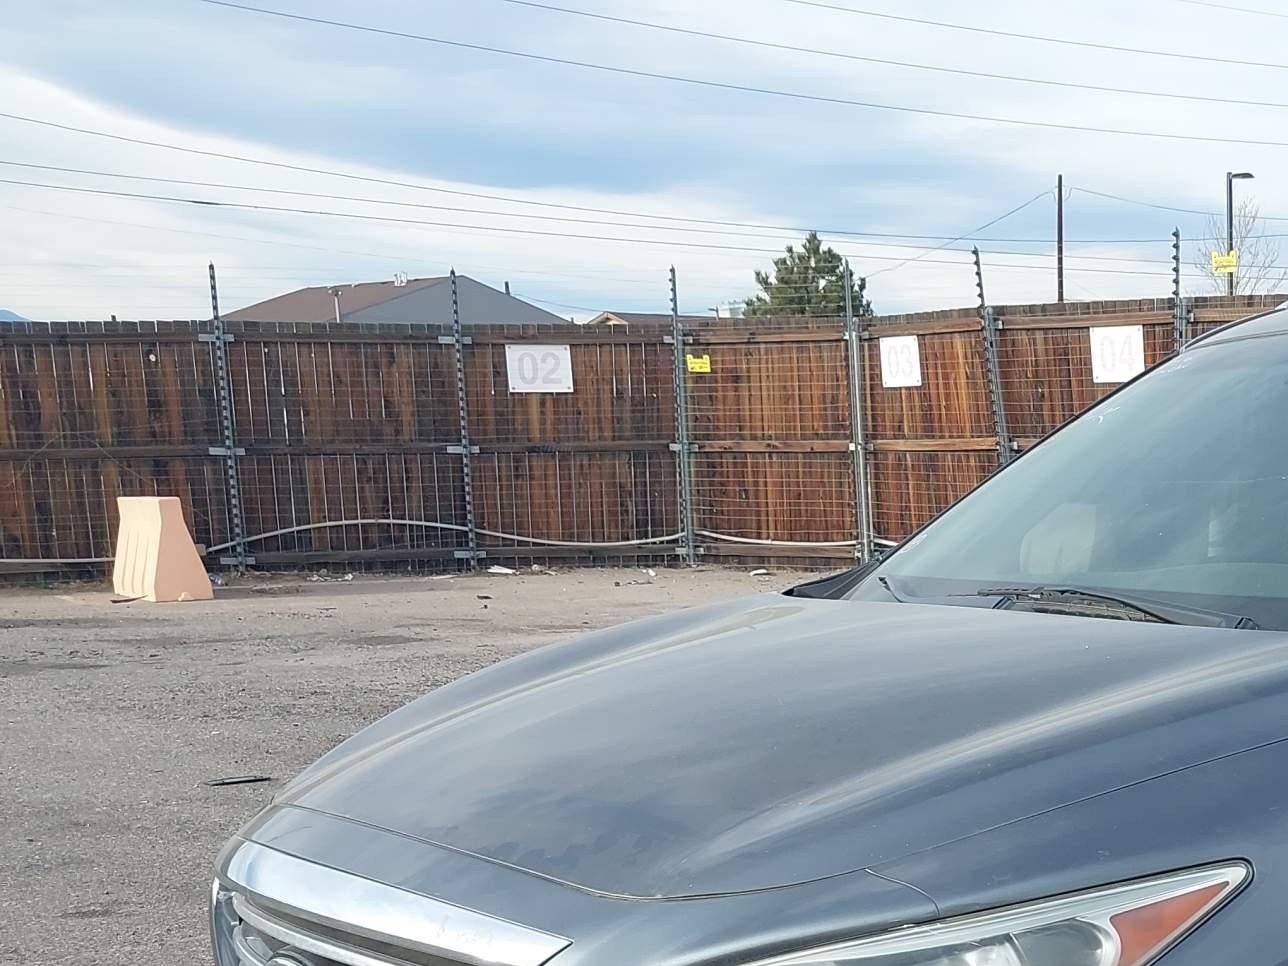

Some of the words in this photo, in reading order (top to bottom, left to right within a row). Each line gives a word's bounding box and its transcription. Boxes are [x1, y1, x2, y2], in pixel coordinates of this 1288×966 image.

[517, 351, 563, 385] 02
[887, 344, 914, 378] 03
[1099, 335, 1137, 372] 04
